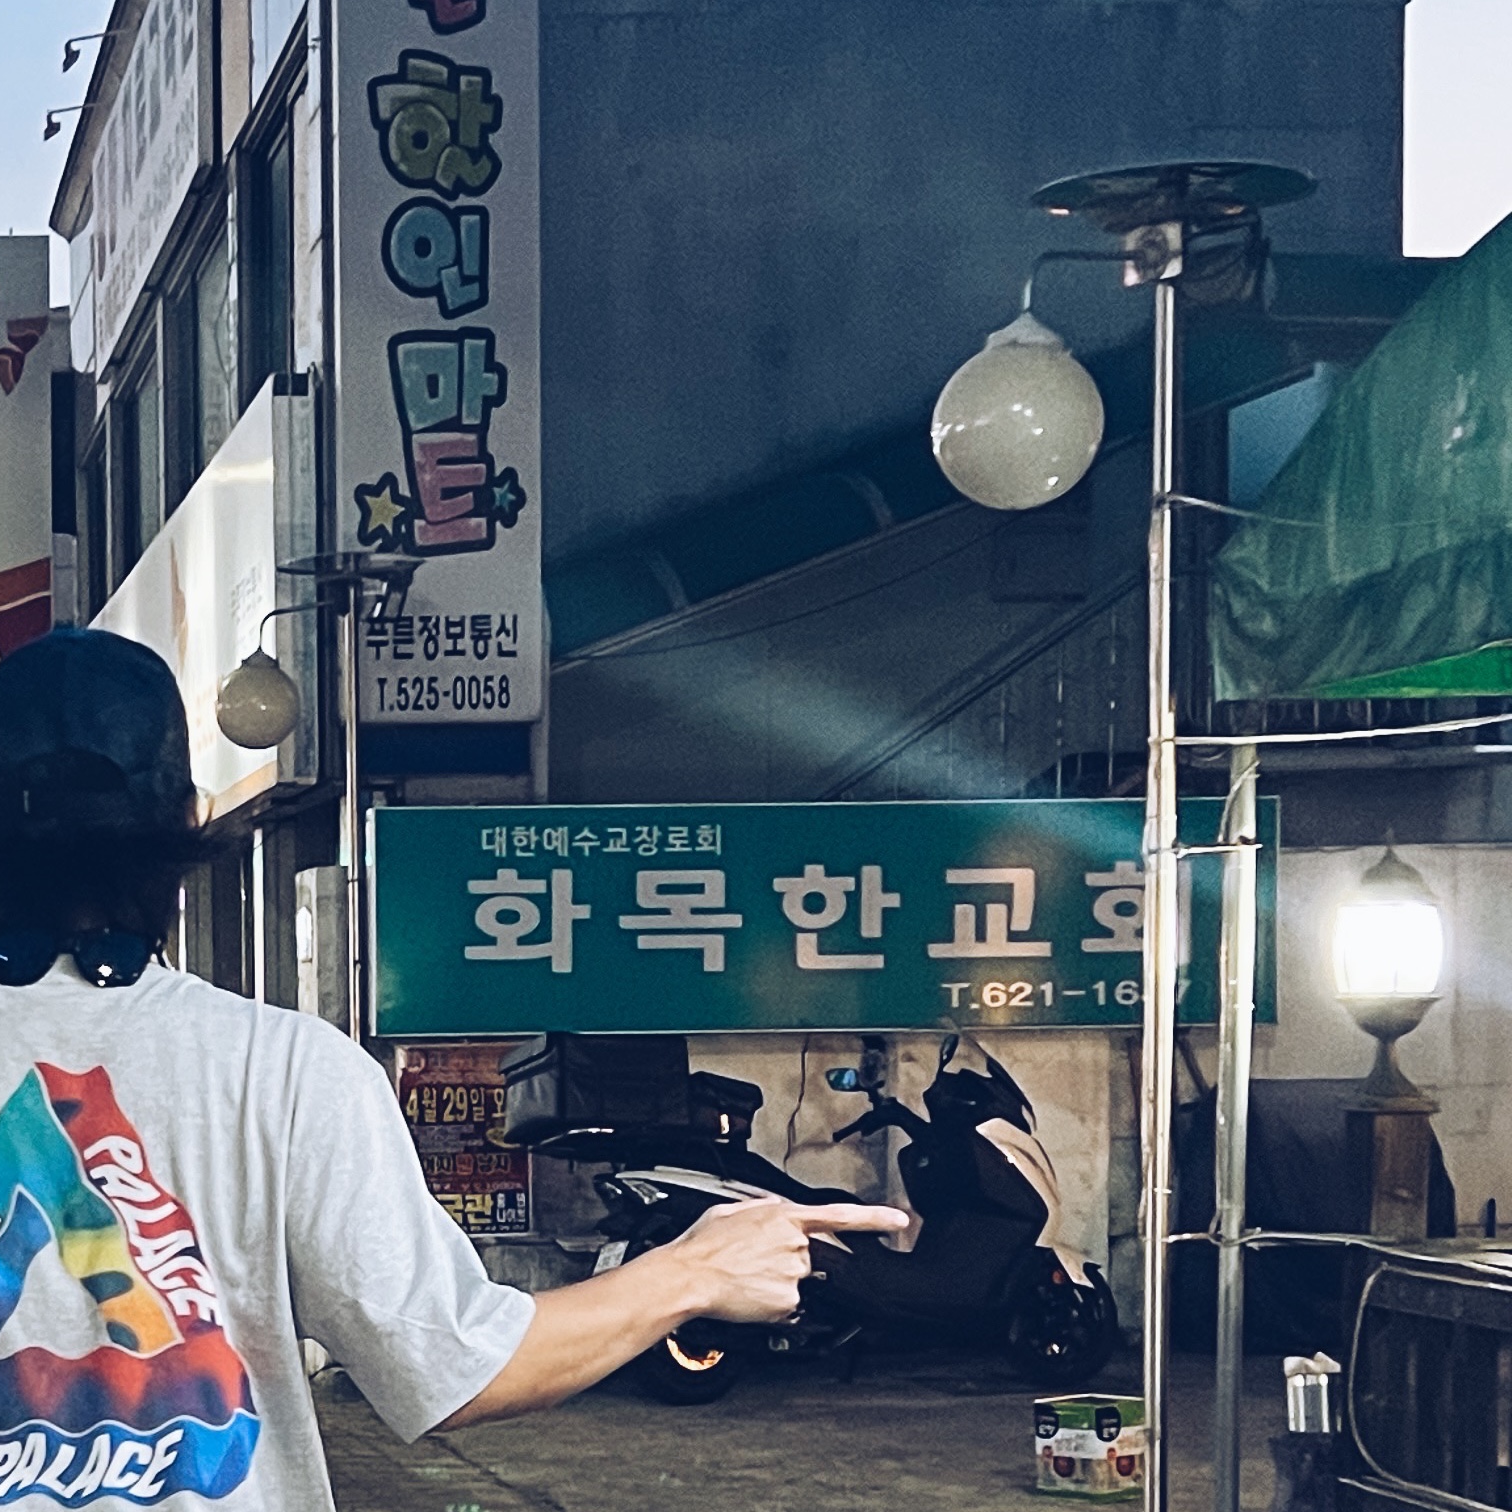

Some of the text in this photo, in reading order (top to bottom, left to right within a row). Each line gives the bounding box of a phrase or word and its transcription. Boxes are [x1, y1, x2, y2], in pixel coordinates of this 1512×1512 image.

[365, 614, 518, 661] 푸른정보통신
[377, 674, 511, 713] T.525-0058
[481, 824, 723, 858] 대한예수교장로회
[941, 980, 1192, 1010] T.621-167
[84, 1135, 223, 1327] PALACE
